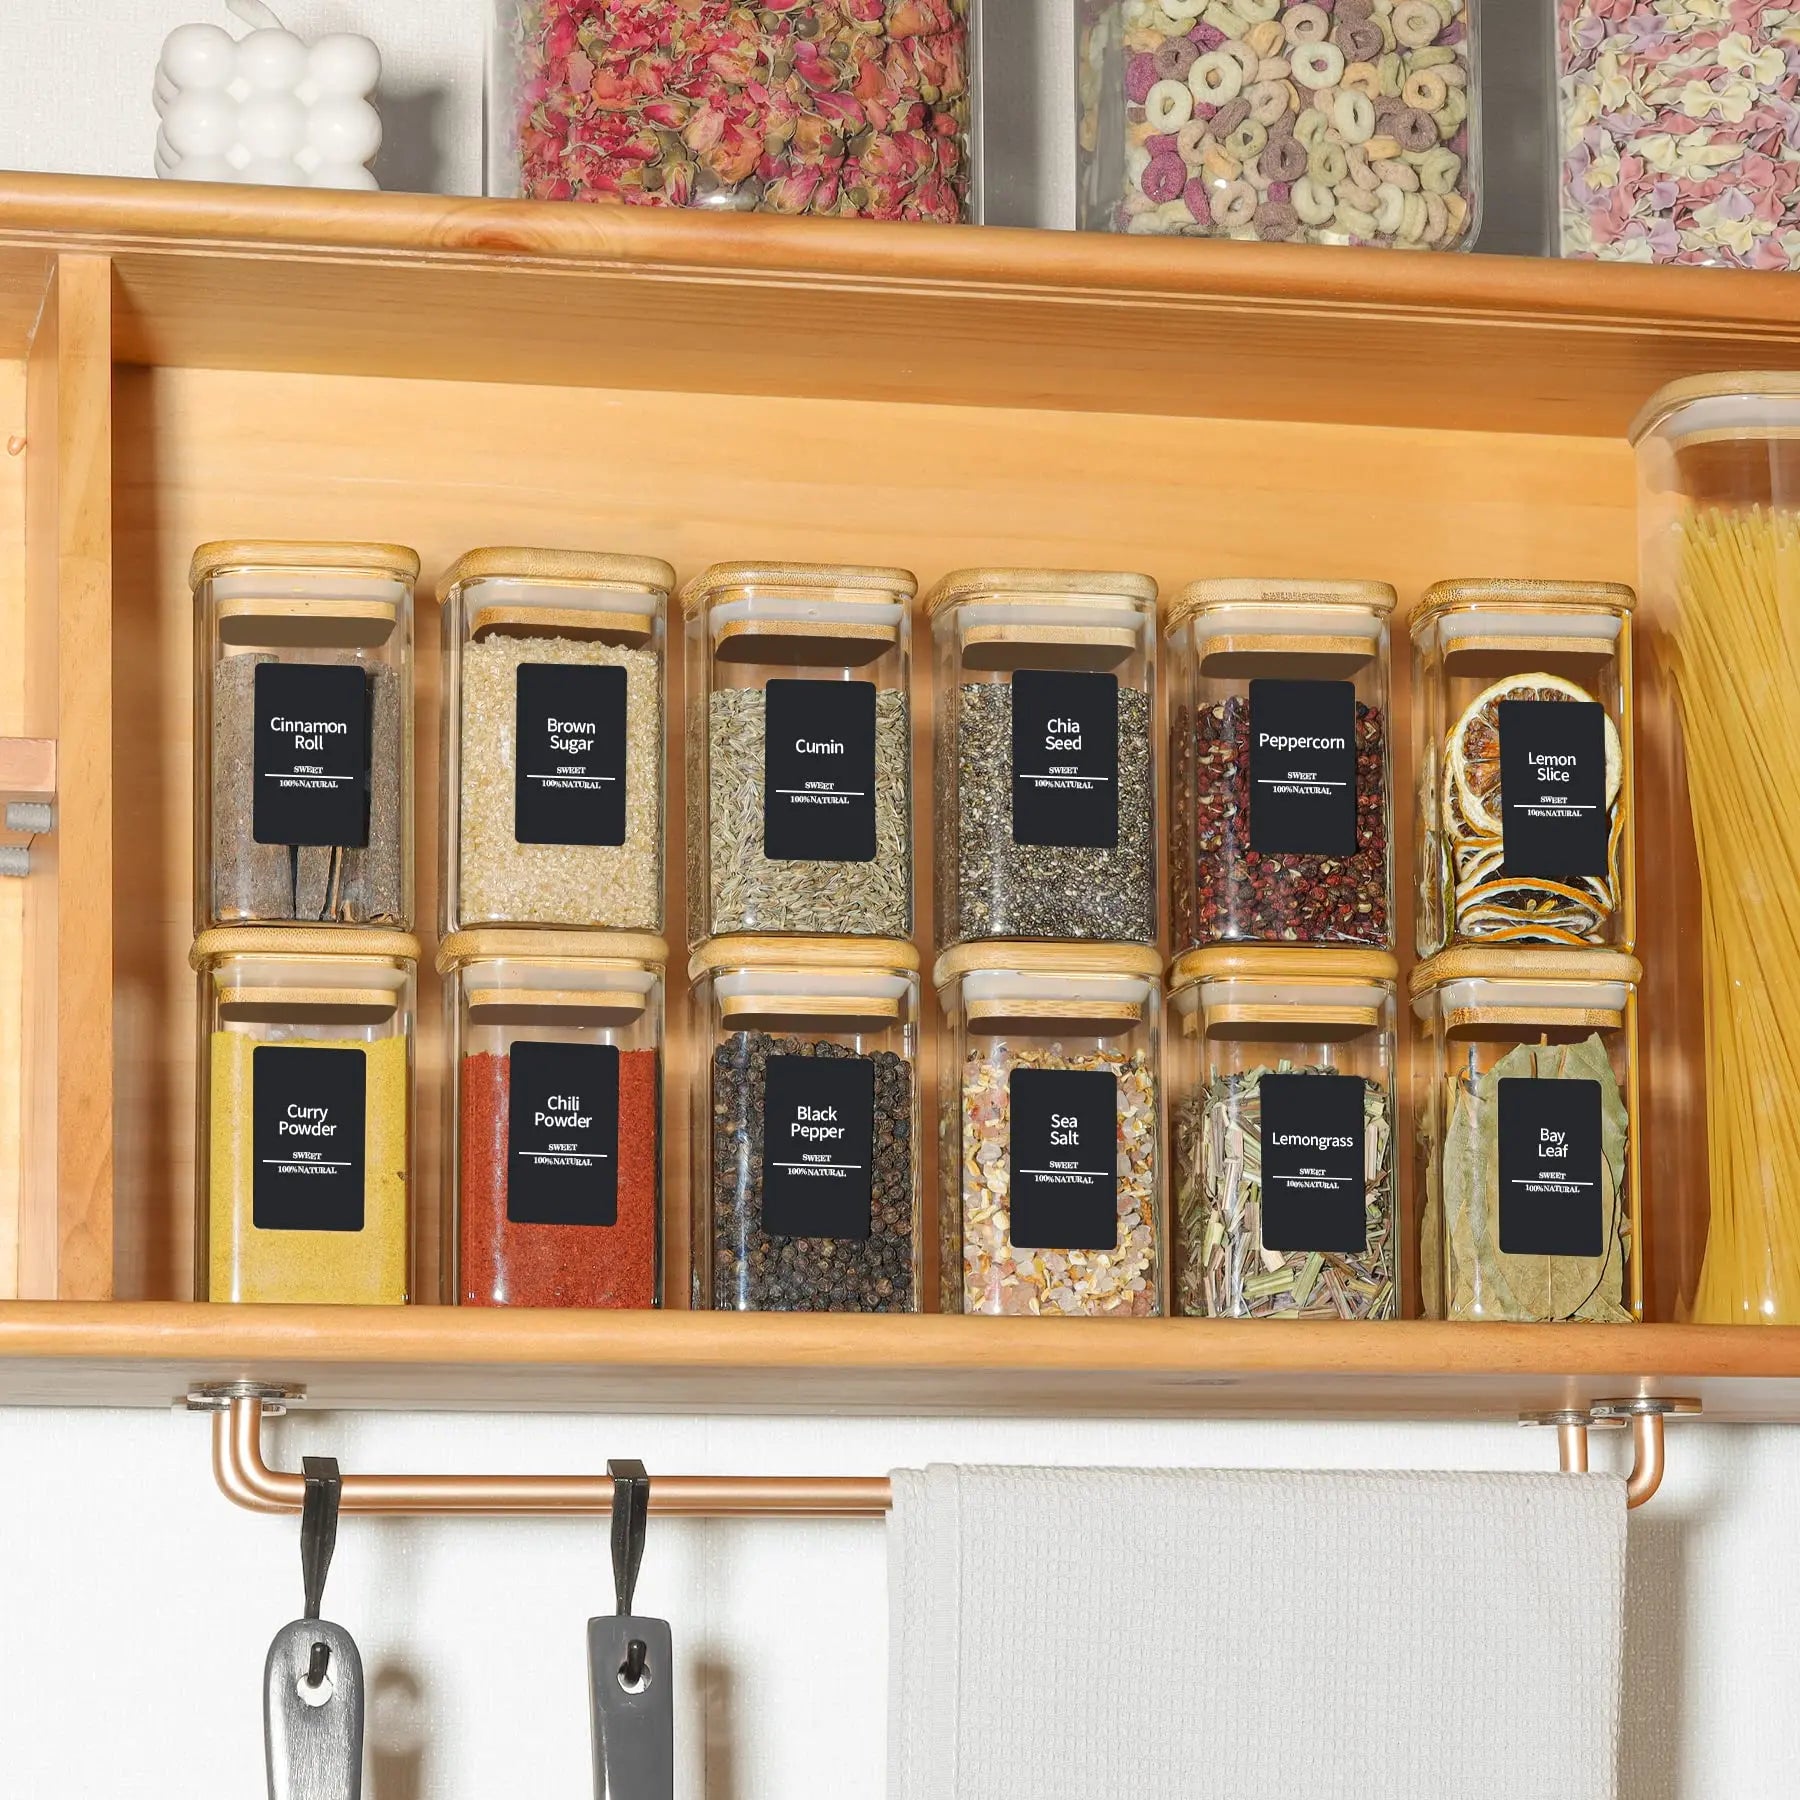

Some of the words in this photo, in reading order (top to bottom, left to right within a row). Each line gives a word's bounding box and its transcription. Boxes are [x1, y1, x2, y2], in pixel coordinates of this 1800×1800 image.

[271, 716, 347, 734] Cinnamon
[547, 717, 596, 734] Brown
[1047, 718, 1081, 733] Chia
[295, 734, 324, 750] Roll
[550, 735, 594, 754] Sugar
[796, 738, 845, 754] Cumin
[1045, 735, 1082, 750] Seed
[1259, 732, 1346, 751] Peppercorn
[1529, 751, 1577, 766] Lemon
[294, 765, 324, 774] SWEET
[557, 765, 587, 774] SWEET
[1048, 765, 1079, 774] SWEET
[1287, 771, 1318, 780] SWEET
[1537, 767, 1570, 782] Slice
[805, 781, 835, 790] SWEET
[1540, 795, 1568, 804] SWEET
[547, 1095, 580, 1111] Chili
[287, 1103, 329, 1122] Curry
[535, 1112, 593, 1128] Powder
[797, 1105, 837, 1121] Black
[1051, 1113, 1078, 1128] Sea
[279, 1121, 337, 1136] Powder
[791, 1123, 845, 1141] Pepper
[1540, 1127, 1566, 1145] Bay
[1050, 1130, 1080, 1145] Salt
[1272, 1131, 1354, 1150] Lemongrass
[548, 1142, 578, 1151] SWEET
[1539, 1144, 1569, 1158] Leaf
[292, 1151, 323, 1160] SWEET
[802, 1153, 832, 1162] SWEET
[1049, 1160, 1079, 1169] SWEET
[1299, 1168, 1327, 1176] SWEET
[1539, 1171, 1567, 1180] SWEET
